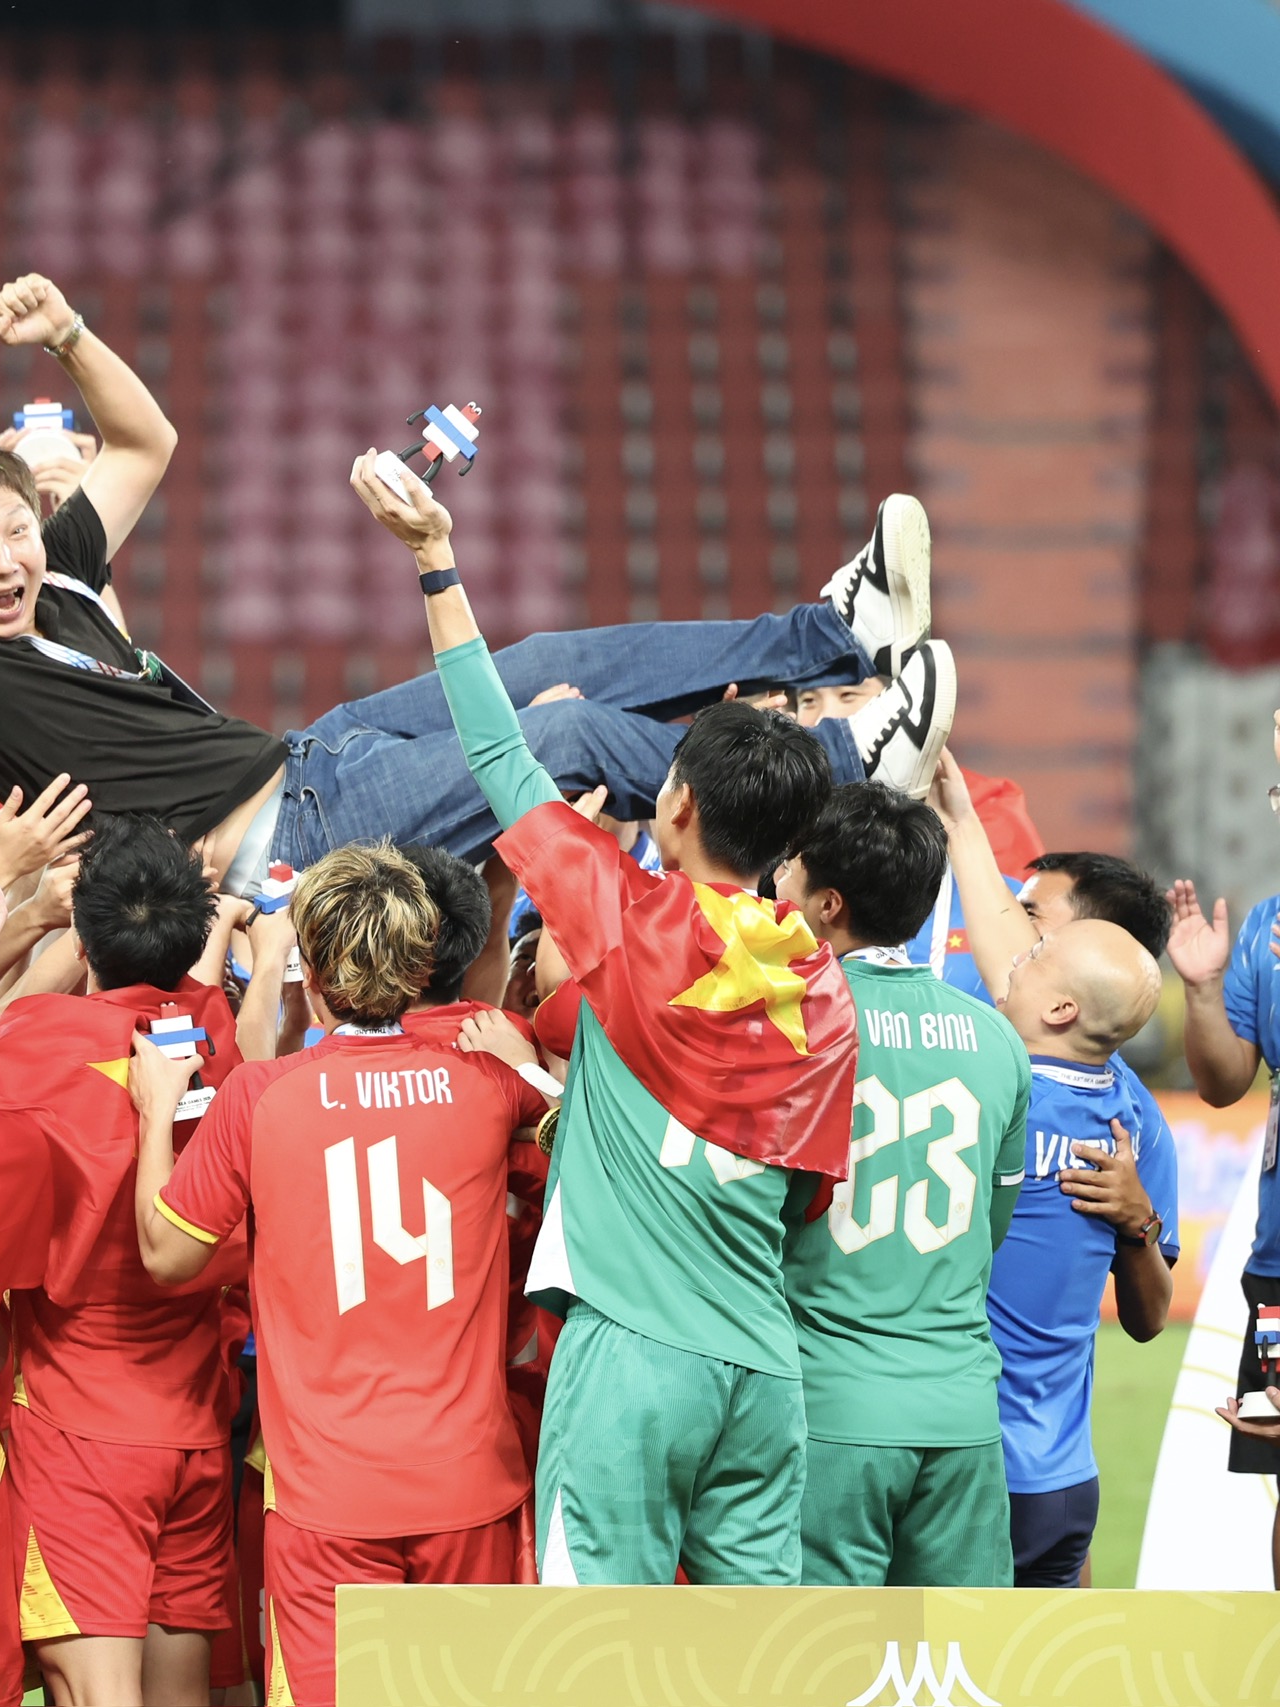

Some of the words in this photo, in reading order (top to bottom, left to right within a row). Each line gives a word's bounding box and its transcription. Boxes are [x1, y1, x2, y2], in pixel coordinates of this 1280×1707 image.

[864, 1008, 912, 1050] VAN
[920, 1011, 978, 1053] BINH
[319, 1072, 347, 1110] L.
[355, 1066, 453, 1109] VIKTOR
[827, 1074, 982, 1255] 23
[324, 1134, 455, 1317] 14
